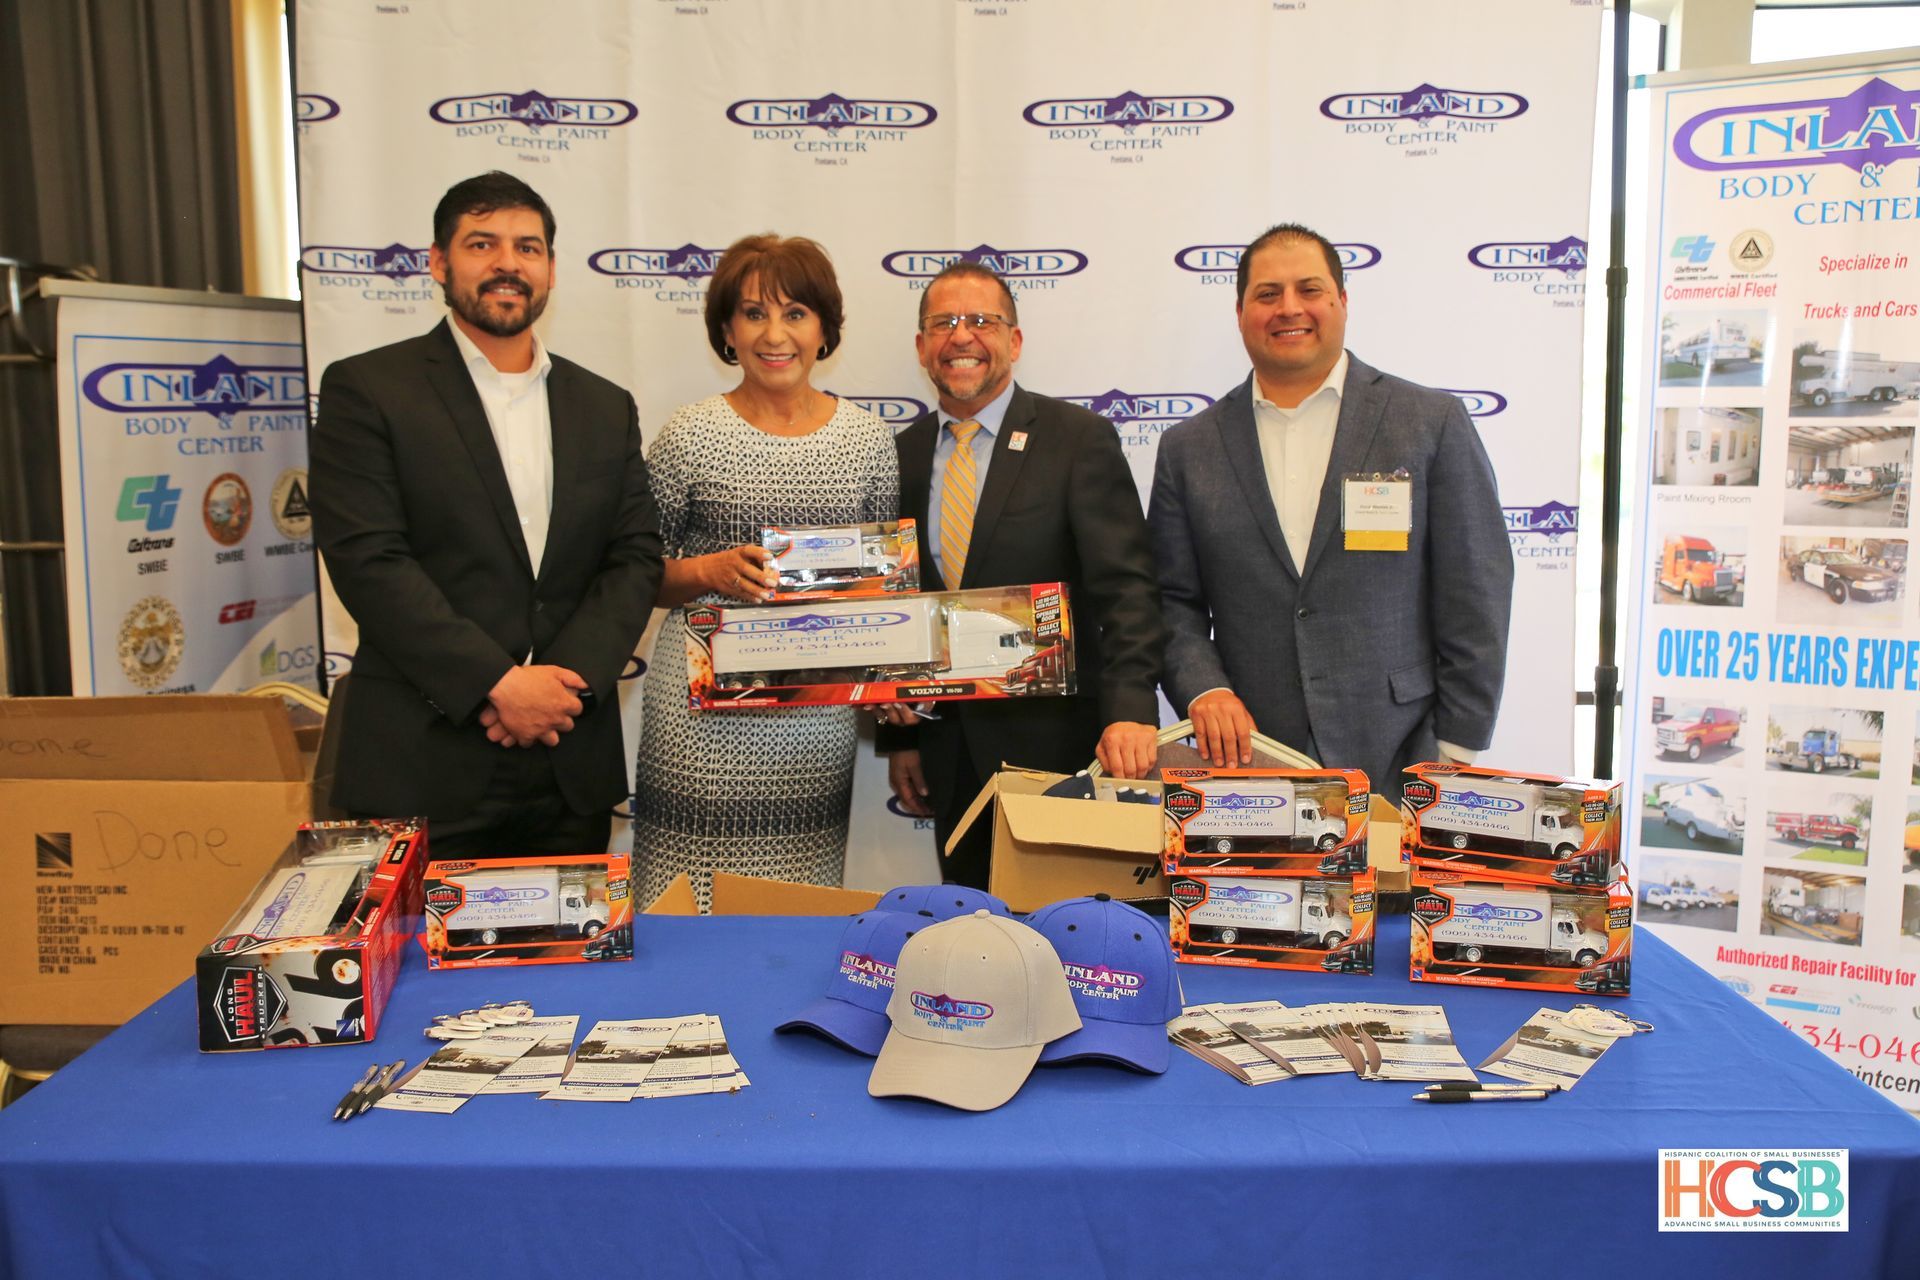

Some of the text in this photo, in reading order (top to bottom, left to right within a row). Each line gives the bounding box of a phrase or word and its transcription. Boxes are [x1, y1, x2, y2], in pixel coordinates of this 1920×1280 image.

[455, 98, 615, 121] INLAND
[1050, 101, 1209, 121] INLAND
[1346, 93, 1505, 114] INLAND
[752, 103, 913, 123] INLAND
[456, 122, 610, 140] BODY & PAINT
[753, 126, 908, 141] BODY & PAINT
[1049, 124, 1203, 140] BODY & PAINT
[1345, 117, 1498, 134] BODY & PAINT
[1721, 106, 1920, 157] INLA
[497, 135, 570, 151] CENTER
[1090, 138, 1163, 151] CENTER
[1385, 131, 1457, 145] CENTER
[794, 141, 867, 153] CENTER
[1719, 163, 1885, 200] BODY &
[1793, 197, 1920, 225] CENTE
[1819, 252, 1908, 275] Specialize in
[319, 276, 372, 288] BODY
[614, 279, 666, 288] BODY
[1009, 279, 1058, 289] PAINT
[1494, 272, 1544, 282] BODY
[362, 290, 433, 300] CENTER
[1663, 281, 1778, 301] Commercial Fleet
[1803, 300, 1918, 319] Trucks and Cars
[122, 372, 307, 403] INLAND
[126, 413, 307, 436] BODY & PAINT
[177, 436, 264, 455] CENTER
[1657, 493, 1681, 504] Paint
[1684, 493, 1715, 505] Mixing
[690, 615, 716, 625] HAUL
[738, 615, 888, 632] INLAND
[1037, 621, 1060, 632] COLLECT
[739, 627, 881, 641] BODY PAINT
[776, 635, 846, 644] CENTER
[738, 640, 887, 654] (909) 434-0466
[277, 645, 316, 673] DGS
[1657, 628, 1720, 679] OVER
[1726, 630, 1759, 681] 25
[1767, 632, 1848, 688] YEARS
[909, 687, 943, 696] VOLVO
[0, 737, 107, 759] one
[1406, 787, 1432, 797] HAUL
[1169, 798, 1197, 807] HAUL
[1451, 810, 1489, 821] CENTER
[1481, 808, 1509, 817] PAINT
[1430, 816, 1510, 831] (909) 434-0466
[93, 809, 242, 873] Done
[1416, 902, 1447, 911] HAUL
[1441, 929, 1528, 941] (909) 434-0466
[1463, 924, 1504, 932] CENTER
[38, 956, 97, 965] MADE IN CHINA
[843, 953, 896, 978] INLAND
[1716, 945, 1917, 987] Authorized Repair Facility for
[847, 974, 878, 989] CENTER
[1064, 964, 1139, 986] INLAND
[1069, 980, 1089, 990] ODY
[1113, 987, 1139, 997] PAINT
[1081, 989, 1120, 1001] CENTER
[227, 987, 235, 1022] LONG
[233, 970, 256, 1037] HAUL
[914, 994, 987, 1016] INLAND
[913, 1008, 934, 1020] BODY
[956, 1018, 985, 1028] PAINT
[927, 1020, 964, 1031] CENTER
[1847, 1064, 1920, 1095] intcen
